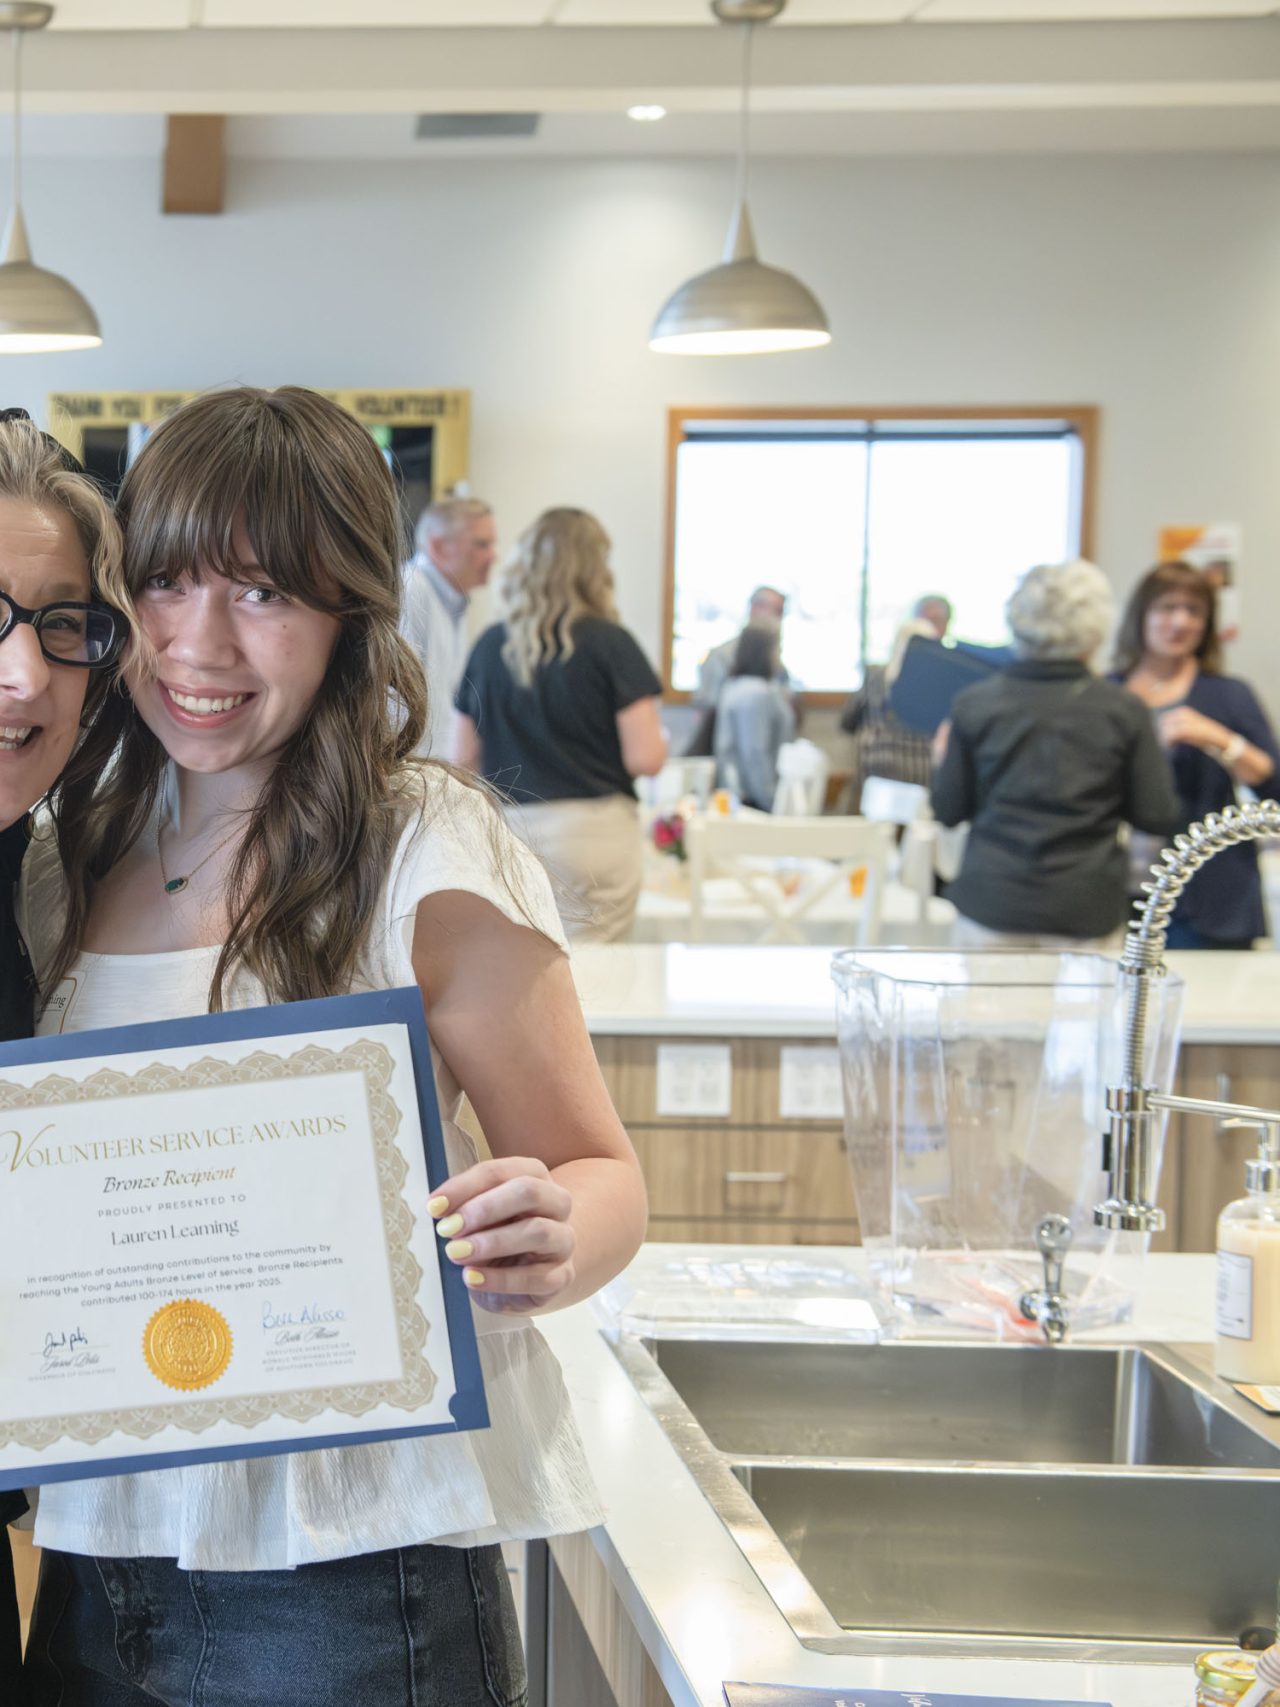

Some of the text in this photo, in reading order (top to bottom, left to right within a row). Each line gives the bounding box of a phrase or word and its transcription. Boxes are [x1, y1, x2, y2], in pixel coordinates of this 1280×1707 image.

[149, 1126, 245, 1154] SERVICE
[248, 1114, 348, 1144] AWARDS
[102, 1166, 237, 1194] Bronze Recipient
[98, 1193, 247, 1217] PROUDLY PRESENTED TO
[111, 1229, 168, 1246] Lauren
[38, 1270, 93, 1284] recognition
[94, 1267, 104, 1277] of
[107, 1260, 164, 1275] outstanding
[166, 1254, 230, 1269] contributions
[232, 1252, 243, 1262] to
[245, 1250, 261, 1260] the
[263, 1245, 318, 1259] community
[319, 1243, 332, 1253] by
[19, 1287, 61, 1300] reaching
[63, 1284, 80, 1295] the
[81, 1281, 112, 1294] Young
[114, 1277, 144, 1289] Adults
[146, 1274, 179, 1285] Bronze
[181, 1271, 206, 1282] Level
[207, 1269, 217, 1279] of
[258, 1262, 290, 1273] Bronze
[293, 1256, 344, 1269] Recipients
[80, 1294, 137, 1307] contributed
[138, 1289, 174, 1300] 100-174
[175, 1284, 202, 1296] hours
[204, 1283, 214, 1294] in
[215, 1281, 232, 1292] the
[233, 1279, 255, 1292] year
